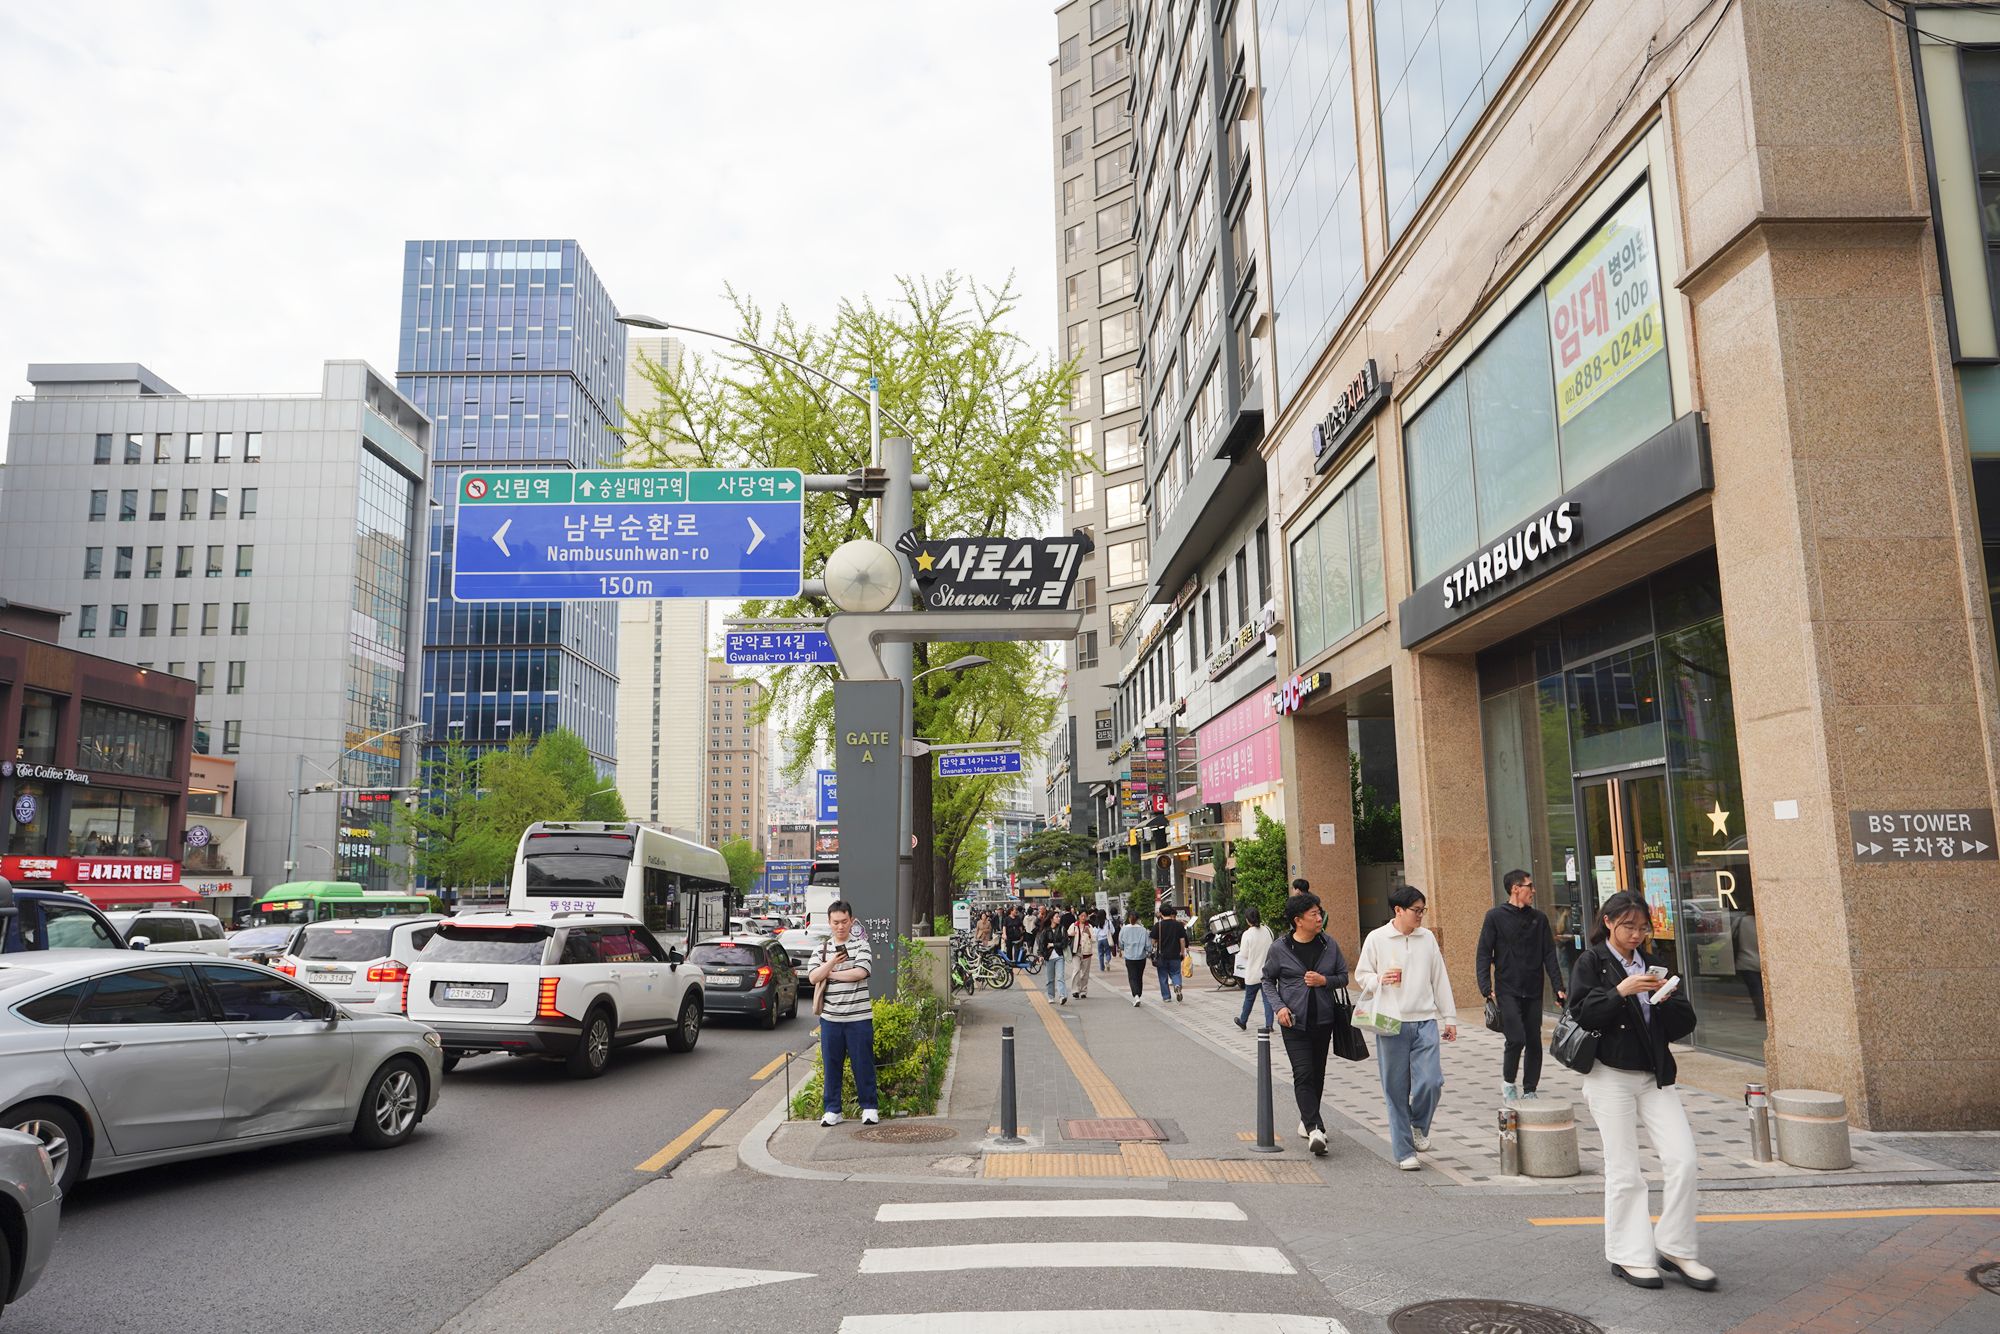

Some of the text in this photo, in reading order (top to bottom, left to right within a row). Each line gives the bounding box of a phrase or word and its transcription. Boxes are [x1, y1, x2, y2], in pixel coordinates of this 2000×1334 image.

[1614, 279, 1649, 321] 100p
[1553, 264, 1610, 369] 임대
[1323, 372, 1366, 441] 미소랑치과
[492, 478, 550, 499] 신림역
[599, 477, 683, 498] 숭실대입구역
[717, 476, 775, 497] 사당역
[563, 513, 699, 542] 남부순환로
[547, 545, 710, 562] Nambusunhwan-ro
[1443, 501, 1574, 609] STARBUCKS
[935, 543, 1080, 606] 샤로수길
[599, 576, 653, 595] 150m
[729, 634, 805, 651] 관악로14길
[729, 651, 818, 662] Gwanak-ro 14-gil
[846, 731, 889, 745] GATE
[861, 750, 874, 763] A
[941, 755, 1007, 768] 관악로14가~나길
[16, 763, 90, 784] The Coffee Bean
[941, 767, 972, 775] Gwanak-ro
[1868, 813, 1971, 834] BS TOWER
[1891, 836, 1956, 859] 주차장
[91, 864, 162, 880] 세계과자 할인점
[1716, 870, 1738, 910] R
